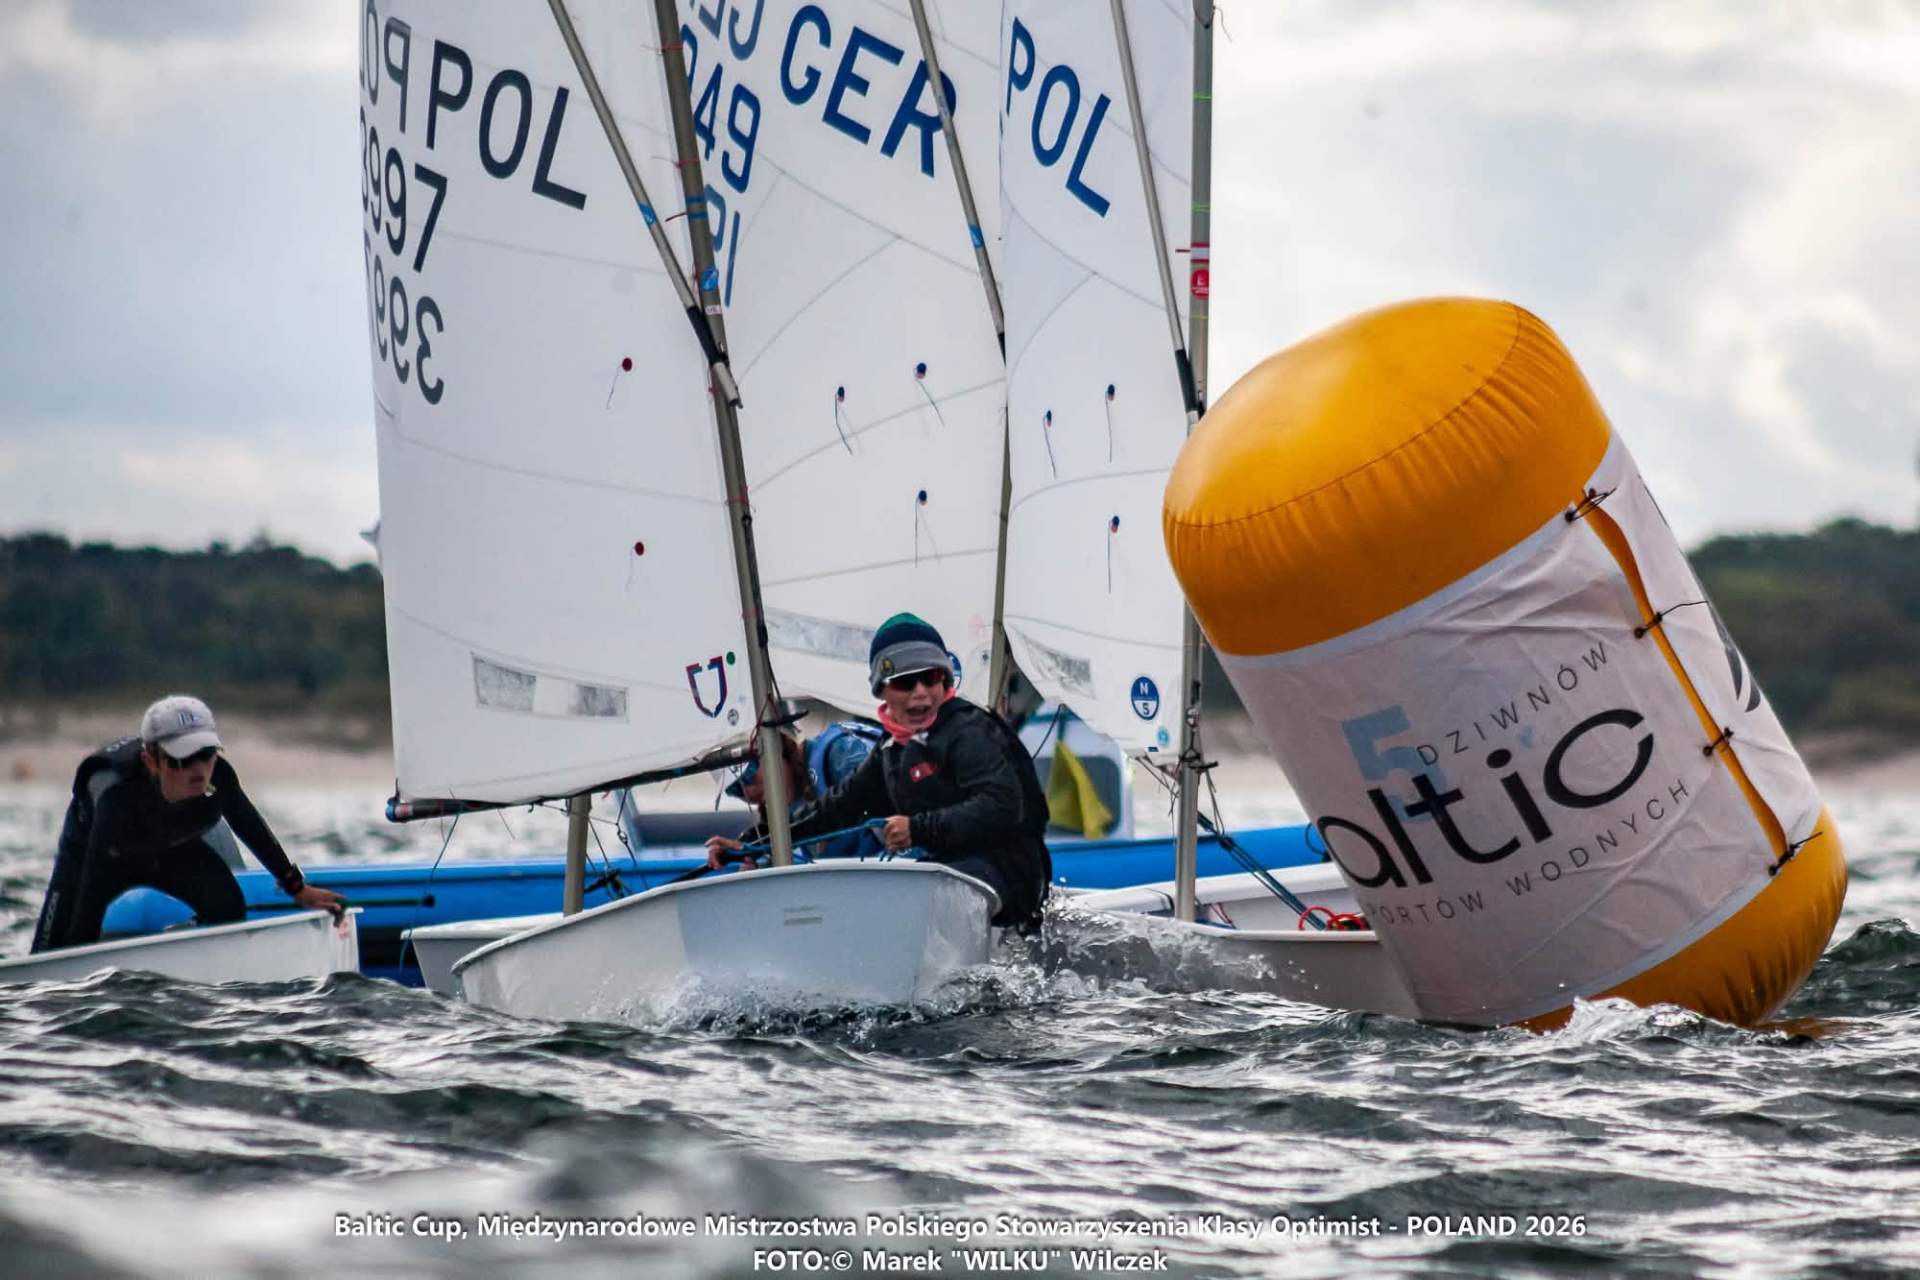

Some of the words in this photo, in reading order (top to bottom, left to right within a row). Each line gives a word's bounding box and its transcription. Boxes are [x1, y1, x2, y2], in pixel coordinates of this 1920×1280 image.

[426, 39, 588, 211] POL
[780, 5, 957, 178] GER
[1007, 16, 1111, 218] POL
[1417, 641, 1609, 766] DZIWNÓW
[1506, 779, 1690, 896] WODNYCH
